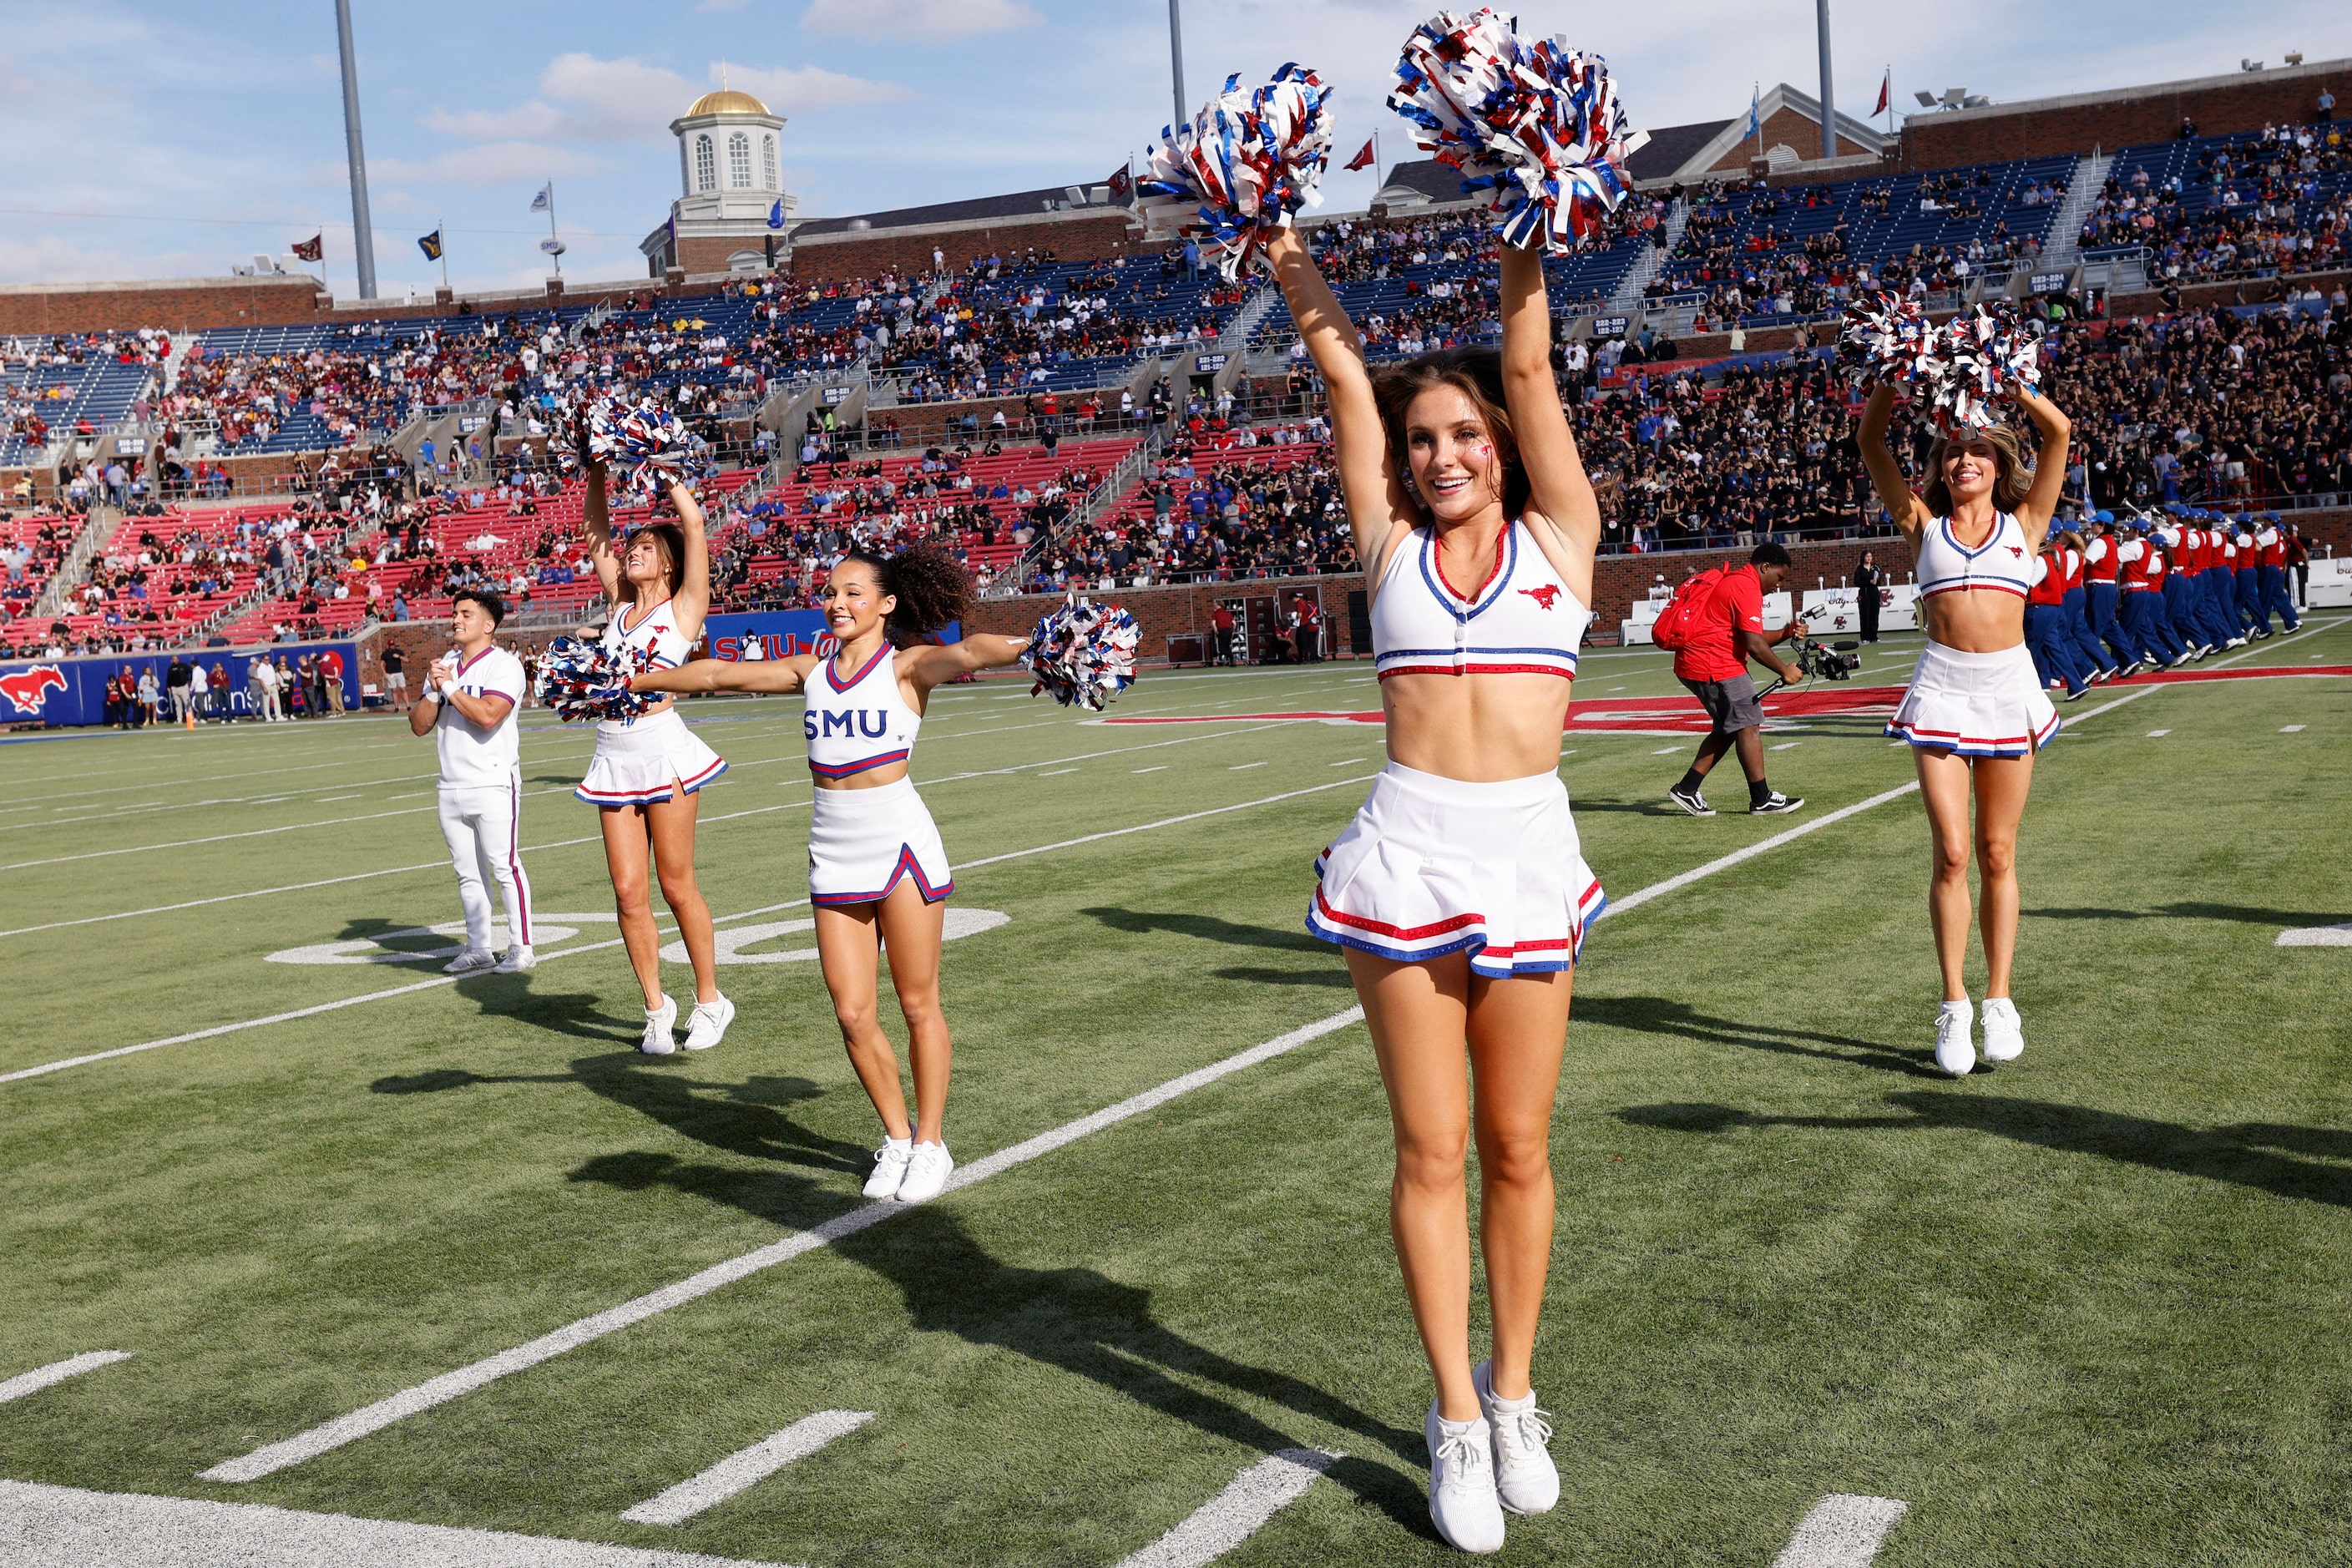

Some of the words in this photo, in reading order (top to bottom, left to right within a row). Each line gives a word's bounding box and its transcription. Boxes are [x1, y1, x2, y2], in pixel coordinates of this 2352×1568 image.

[541, 241, 558, 250] SMU
[2031, 274, 2064, 284] 223-224
[2034, 282, 2063, 292] 123-124
[1596, 318, 1626, 326] 222-223
[1598, 326, 1624, 335] 122-123
[1199, 355, 1225, 363] 221-222
[825, 387, 850, 396] 220-221
[827, 395, 847, 403] 120-12
[1187, 529, 1195, 539] 11
[715, 633, 796, 662] SU
[804, 710, 888, 740] SMU
